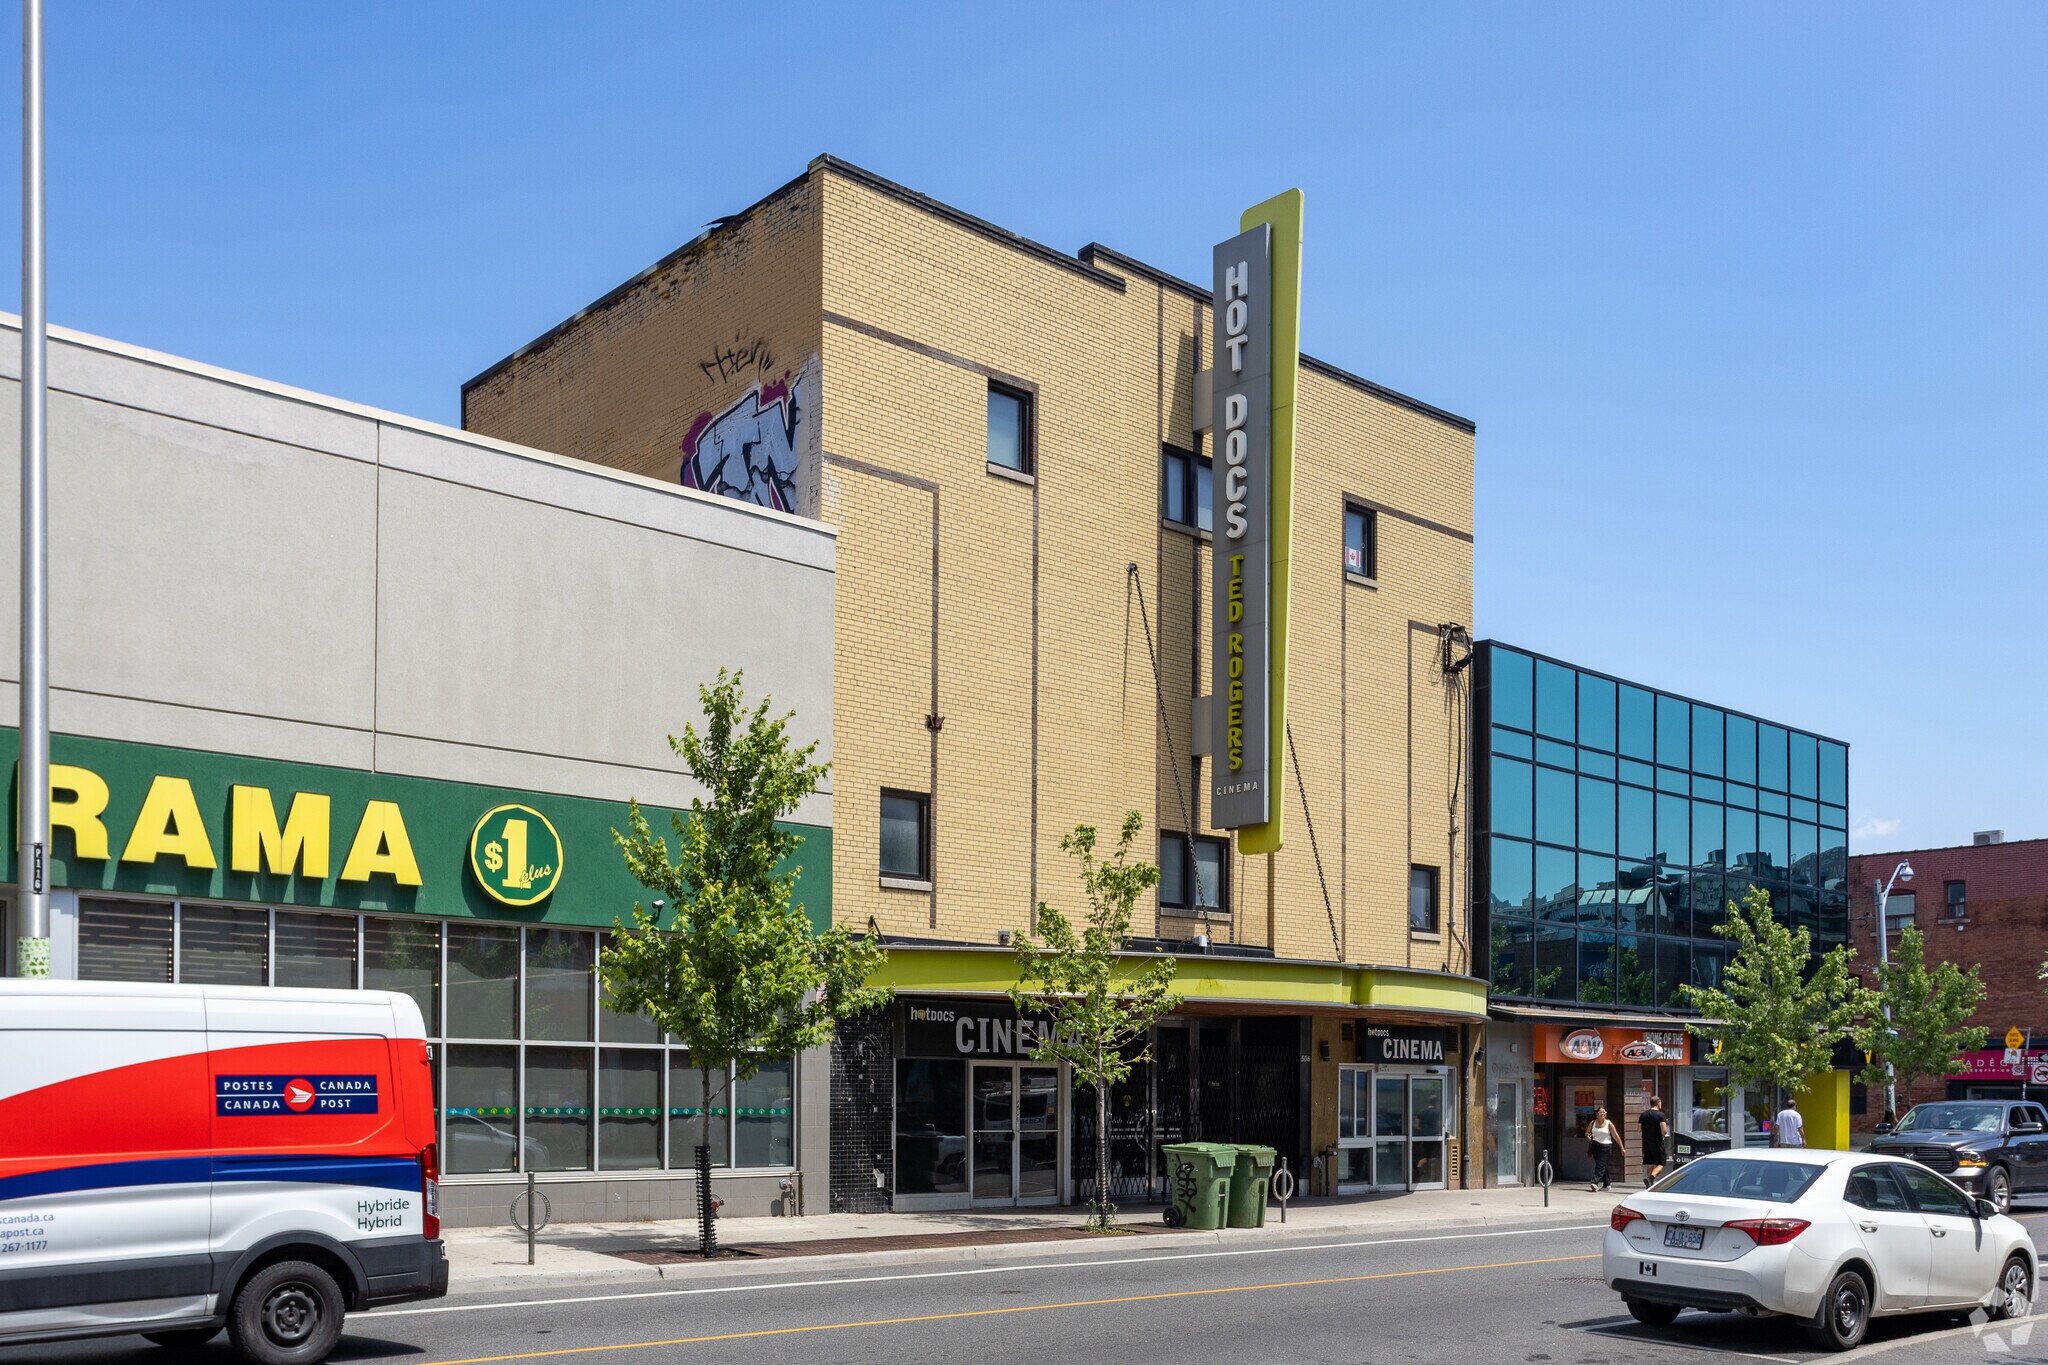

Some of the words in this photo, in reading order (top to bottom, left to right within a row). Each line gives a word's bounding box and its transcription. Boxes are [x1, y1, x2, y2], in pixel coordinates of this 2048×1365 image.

[1225, 261, 1248, 374] HOT
[1225, 393, 1248, 539] DOCS
[1228, 554, 1245, 624] TED
[1228, 632, 1245, 771] ROGERS
[1216, 781, 1259, 796] CINEMA
[17, 762, 424, 887] RAMA
[520, 864, 552, 889] plus
[1383, 1038, 1443, 1060] CINEMA
[1570, 1040, 1601, 1055] A&W
[224, 1081, 273, 1091] POSTES
[320, 1081, 371, 1090] CANADA
[224, 1100, 281, 1110] CANADA
[320, 1099, 351, 1108] POST
[357, 1198, 410, 1215] Hybride
[357, 1215, 402, 1232] Hybrid
[1, 1240, 48, 1253] 267-1177
